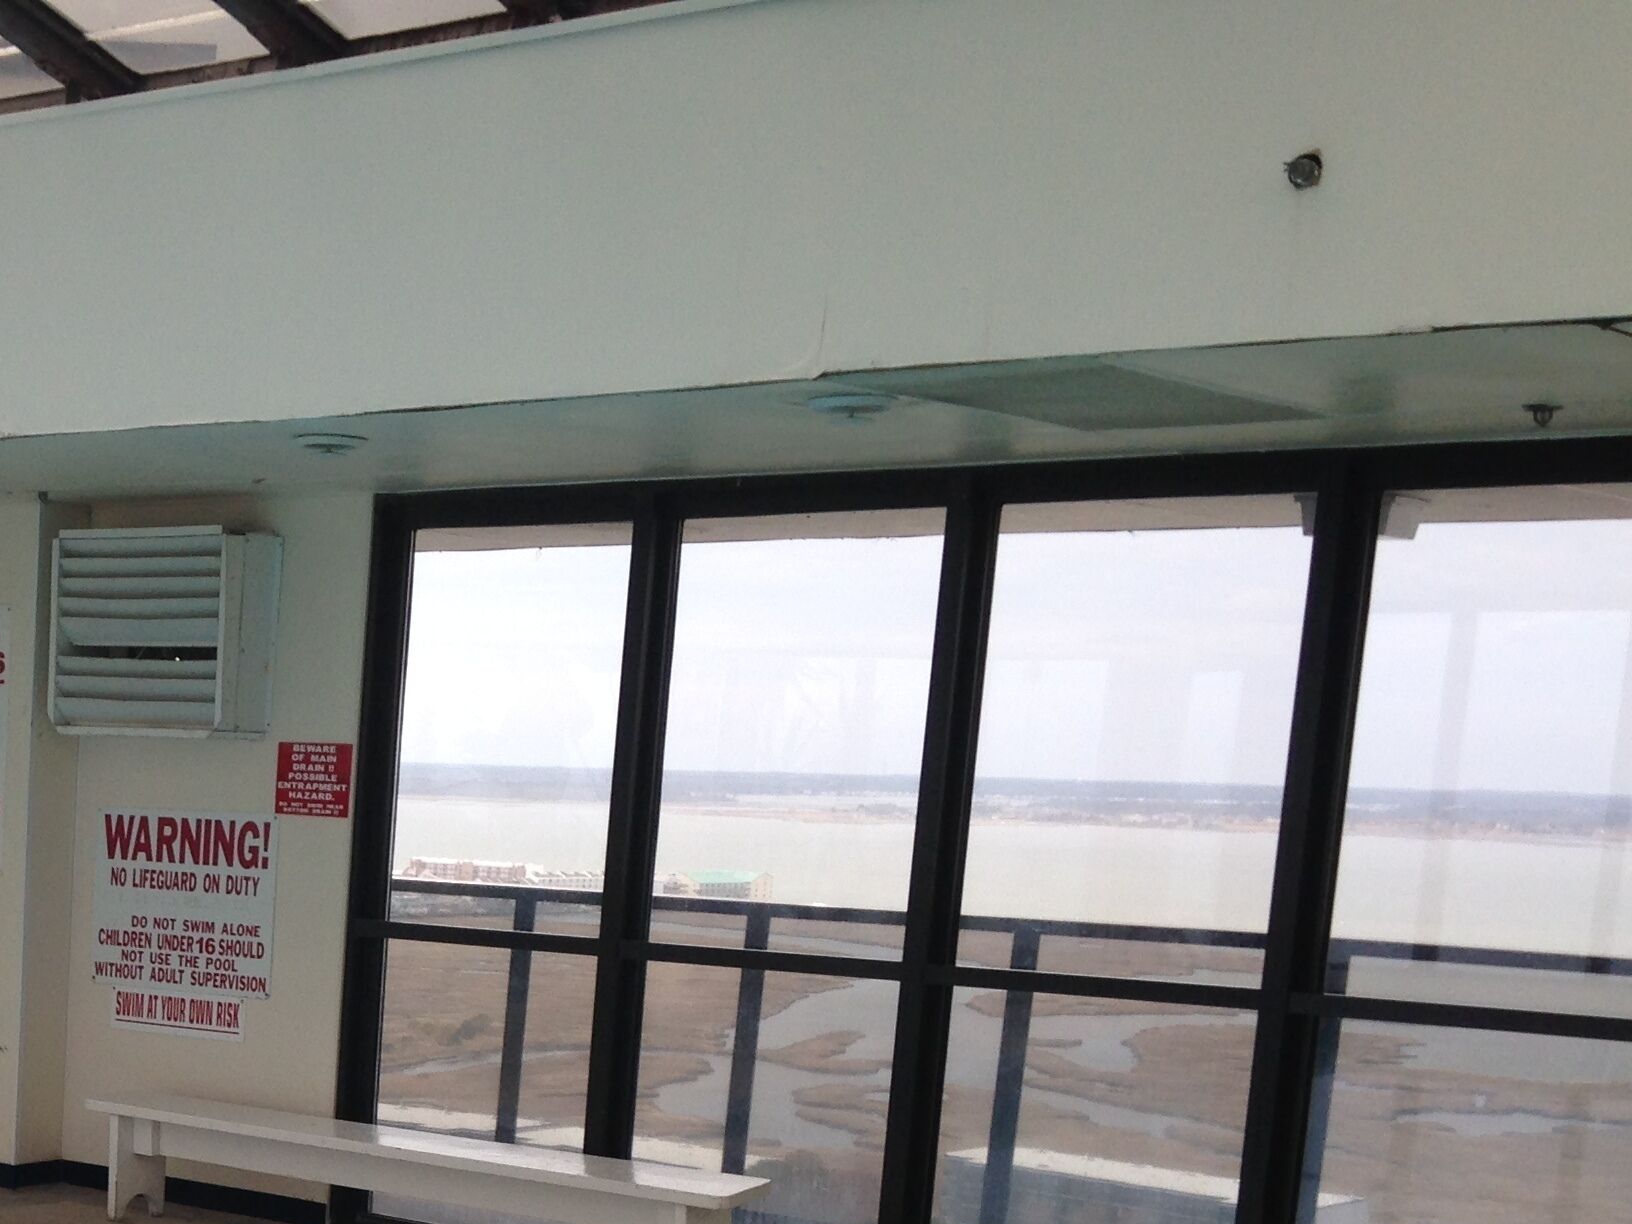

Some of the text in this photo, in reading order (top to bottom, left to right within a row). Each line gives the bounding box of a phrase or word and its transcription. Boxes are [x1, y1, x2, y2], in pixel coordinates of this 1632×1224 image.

[293, 744, 336, 753] BEWARE
[311, 754, 336, 762] MAIN
[288, 772, 337, 781] POSSIBLE
[293, 763, 324, 771] DRAIN
[278, 781, 347, 791] ENTRAPMENT
[289, 792, 335, 801] HAZARD.
[104, 814, 271, 870] WARNING!
[110, 867, 260, 896] NO LIFEGUARD ON DUTY
[131, 916, 261, 937] DO NOT SWIM ALONE
[98, 929, 264, 959] CHILDREN UNDER 16 SHOULD
[121, 950, 237, 972] NOT USE THE POOL
[95, 961, 266, 993] WITHOUT ADULT SUPERVISION
[116, 990, 239, 1028] SWIM AT YOUR OWN RISK
